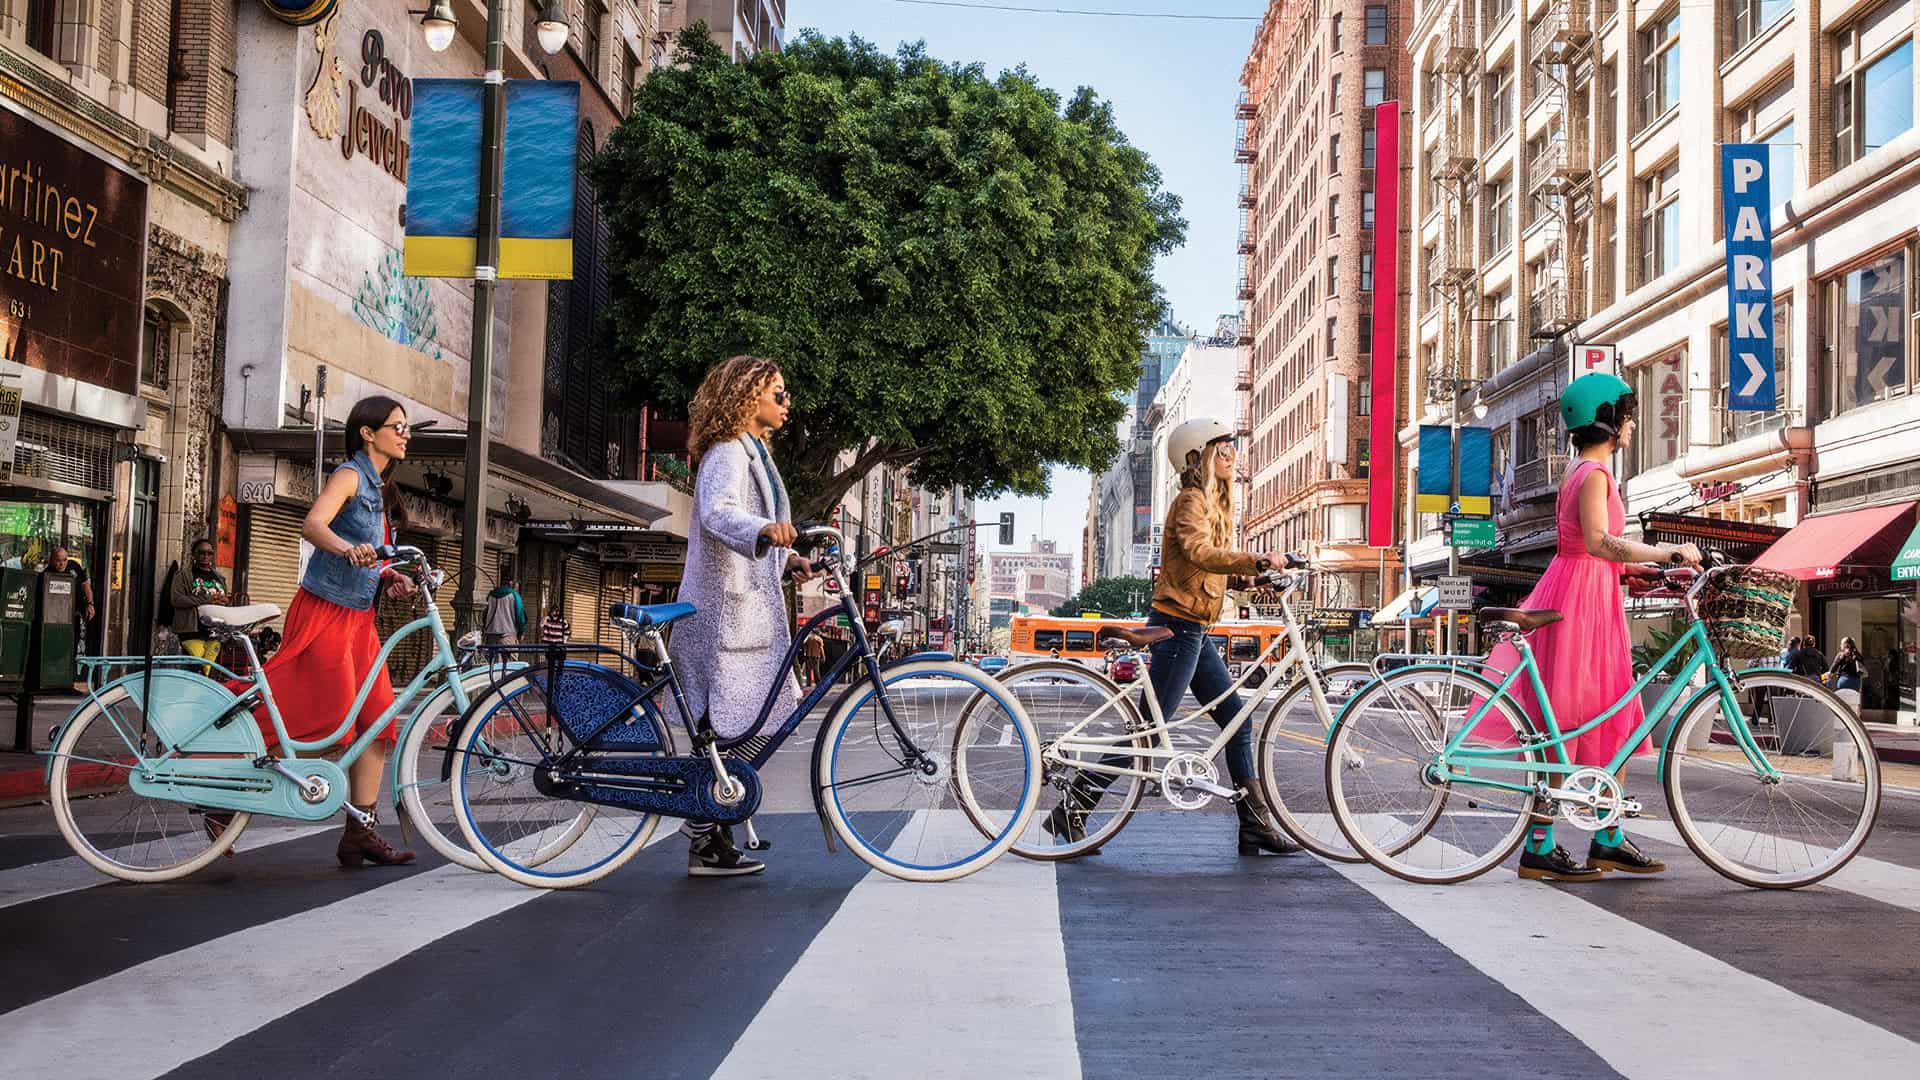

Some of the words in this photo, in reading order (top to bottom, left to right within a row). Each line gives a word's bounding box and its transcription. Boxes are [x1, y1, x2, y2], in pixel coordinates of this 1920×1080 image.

[361, 29, 412, 120] Pavo
[0, 226, 63, 292] ART
[1733, 158, 1767, 339] PARK
[1586, 349, 1605, 369] P
[242, 481, 274, 504] 640
